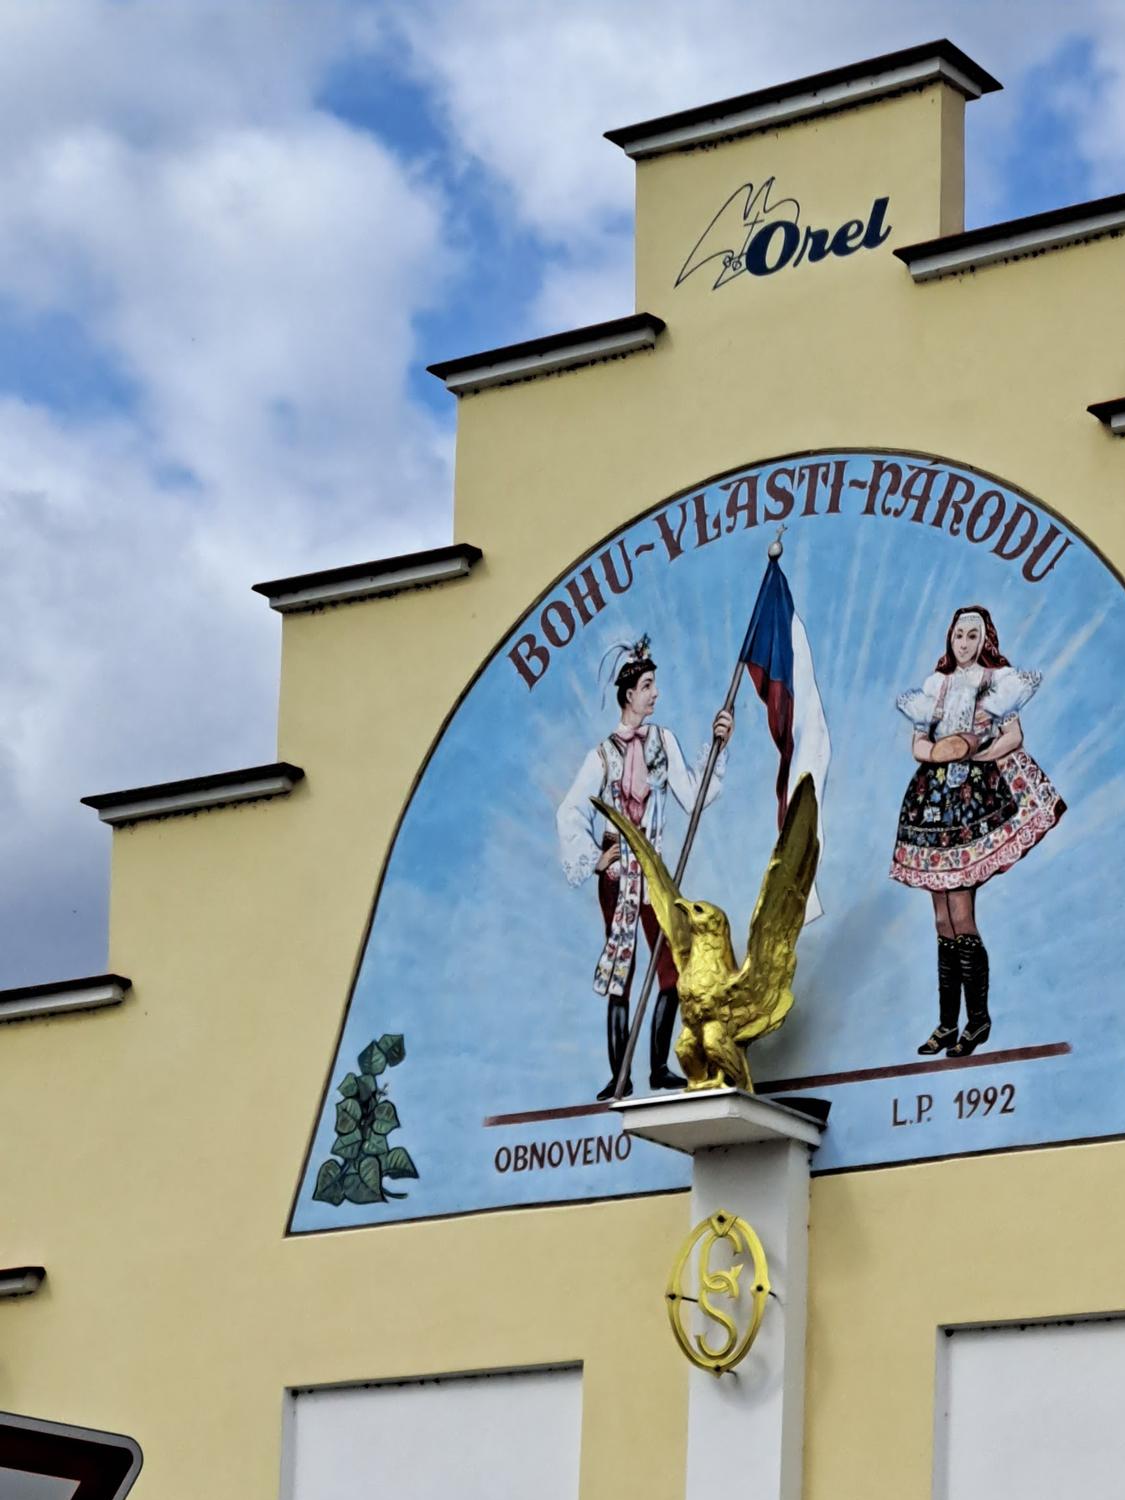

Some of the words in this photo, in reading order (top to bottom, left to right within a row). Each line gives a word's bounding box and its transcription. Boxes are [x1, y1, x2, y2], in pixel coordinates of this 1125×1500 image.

[746, 196, 893, 277] Orel
[494, 1131, 632, 1174] OBNOVENO
[953, 1083, 1016, 1120] 1992
